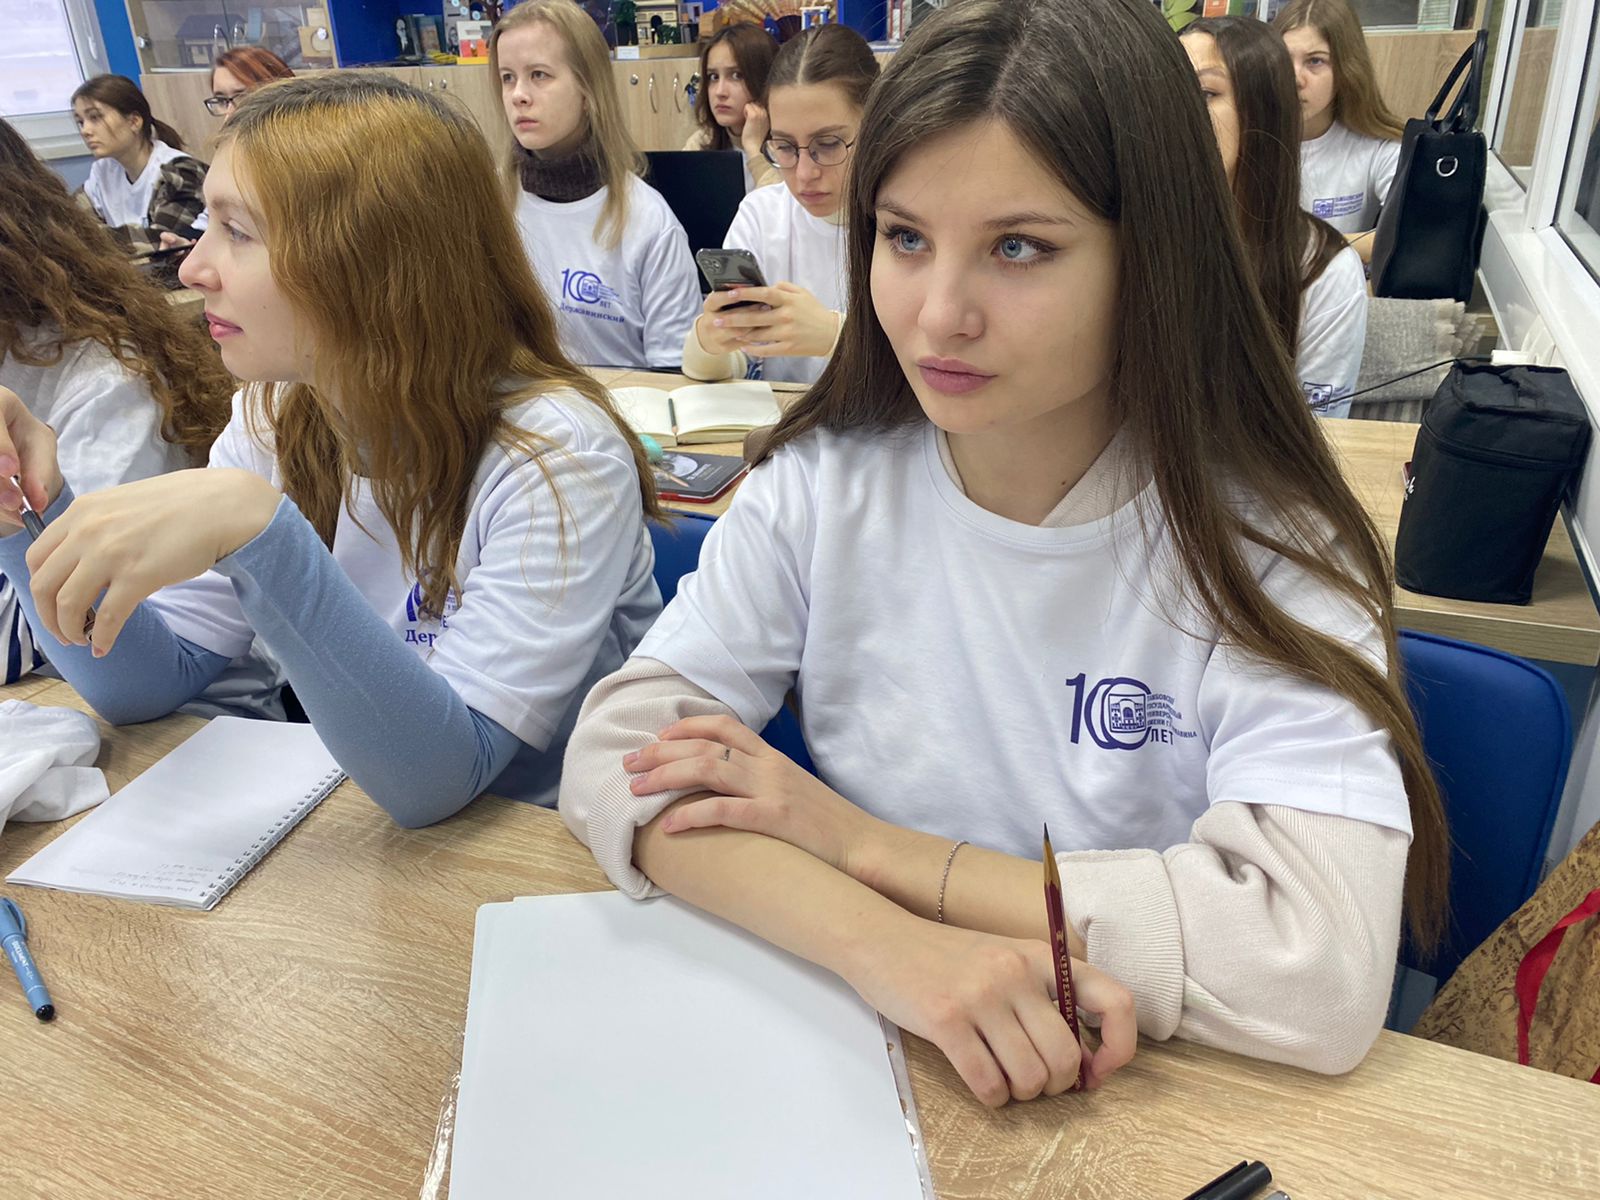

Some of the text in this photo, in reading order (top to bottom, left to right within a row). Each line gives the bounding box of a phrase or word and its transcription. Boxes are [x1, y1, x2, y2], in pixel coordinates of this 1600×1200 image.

[405, 629, 437, 647] Дер
[1065, 672, 1152, 751] 100
[1150, 728, 1174, 745] ЛЕТ
[1059, 955, 1074, 1021] ЧЕРТЕЖНИК
